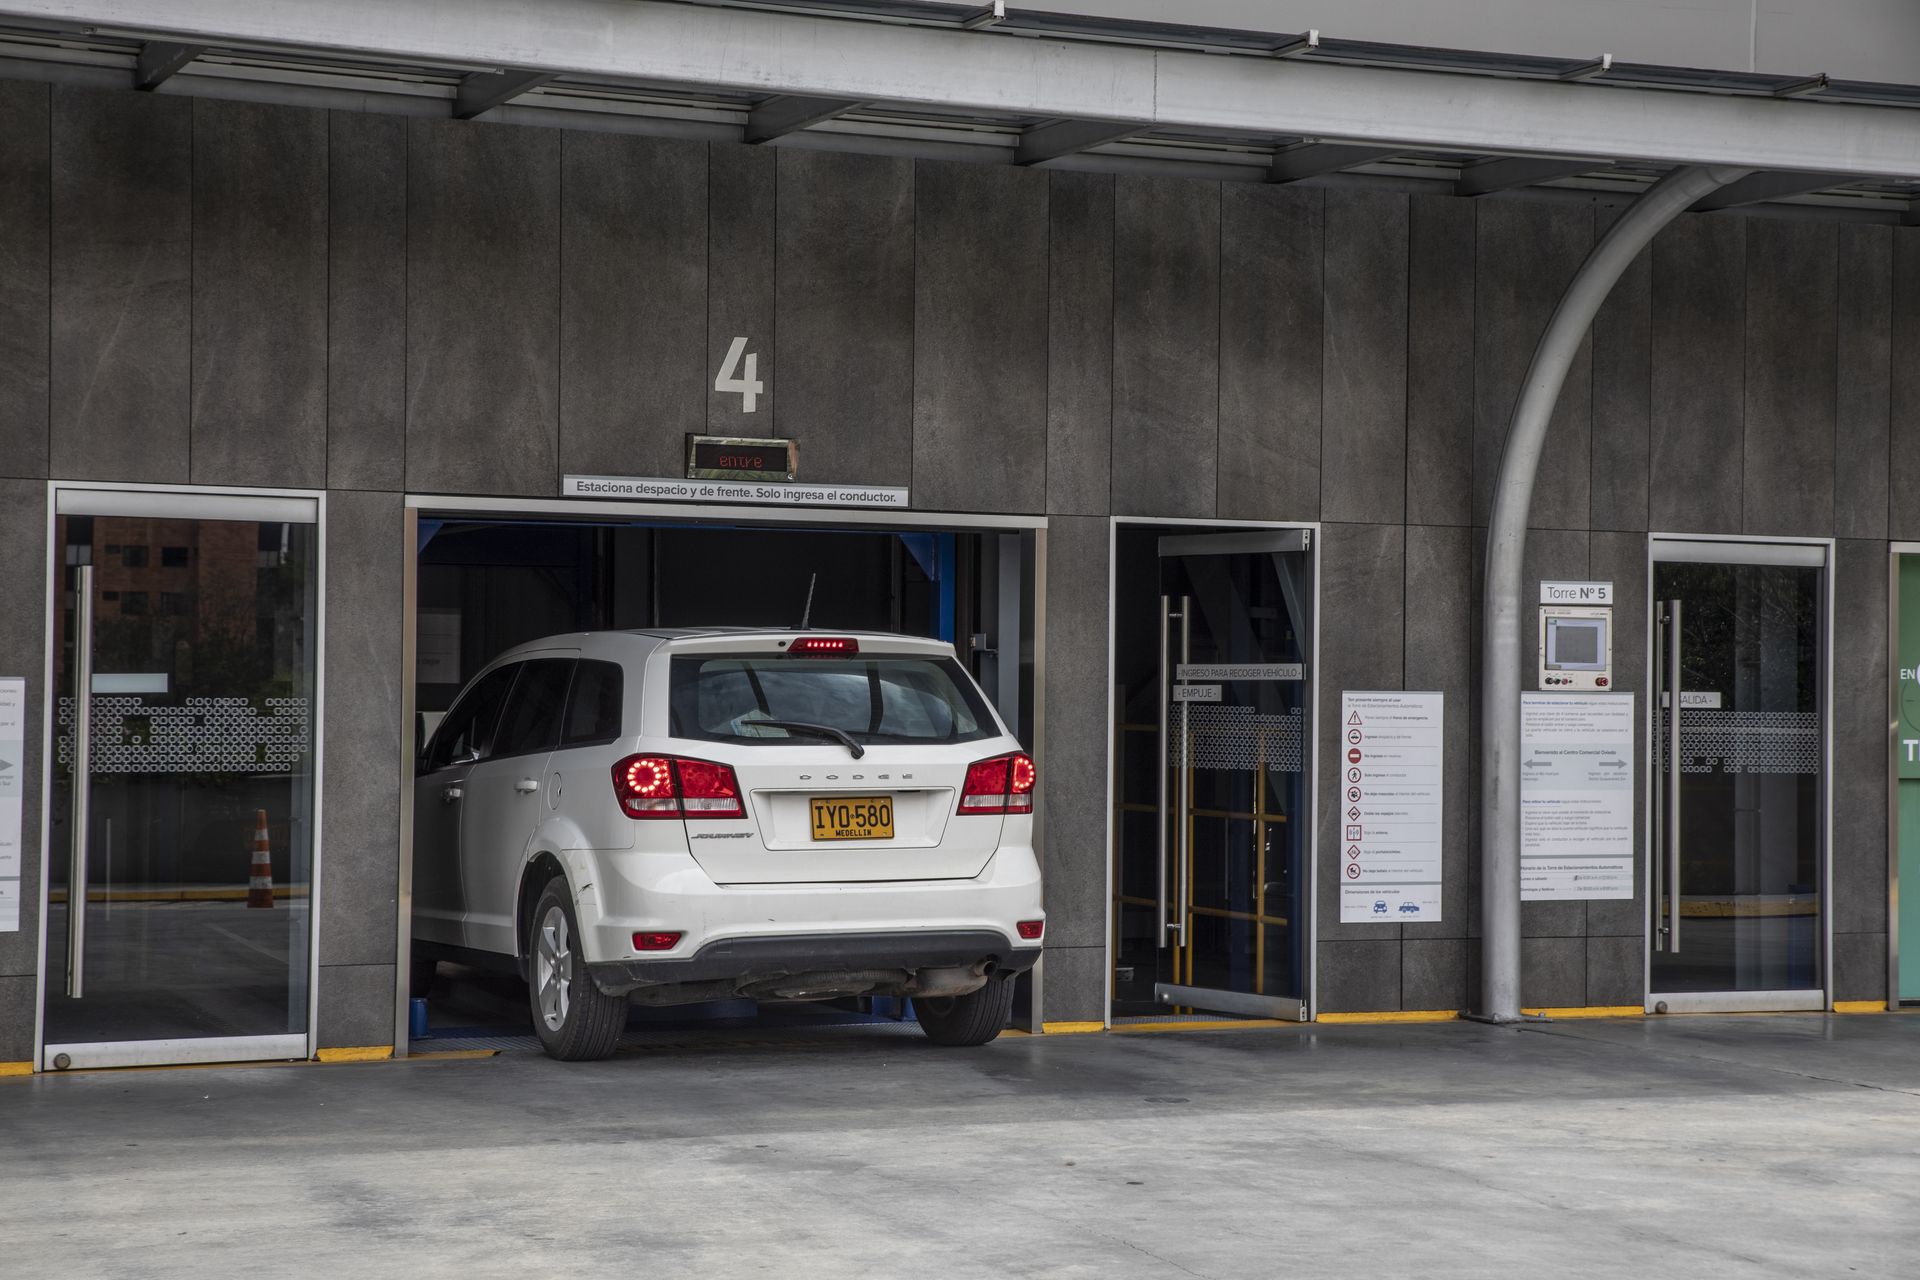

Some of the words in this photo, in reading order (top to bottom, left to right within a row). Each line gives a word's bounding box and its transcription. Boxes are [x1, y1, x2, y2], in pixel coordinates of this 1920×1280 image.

[715, 337, 763, 413] 4
[719, 455, 763, 469] entre
[576, 481, 633, 493] Estaciona
[635, 483, 688, 497] despacio
[690, 487, 698, 498] y
[700, 485, 715, 497] de
[717, 486, 754, 498] frente.
[756, 487, 781, 499] Solo
[783, 488, 824, 502] ingresa
[827, 490, 837, 500] el
[839, 491, 896, 503] conductor.
[1547, 586, 1577, 599] Torre
[1598, 587, 1606, 599] 5
[1182, 668, 1210, 678] INGRESO
[1211, 668, 1228, 678] PARA
[1229, 668, 1261, 678] RECOGER
[1182, 688, 1213, 698] EMPUJE
[1680, 695, 1708, 704] ALIDA
[835, 829, 872, 837] MEDELLIN
